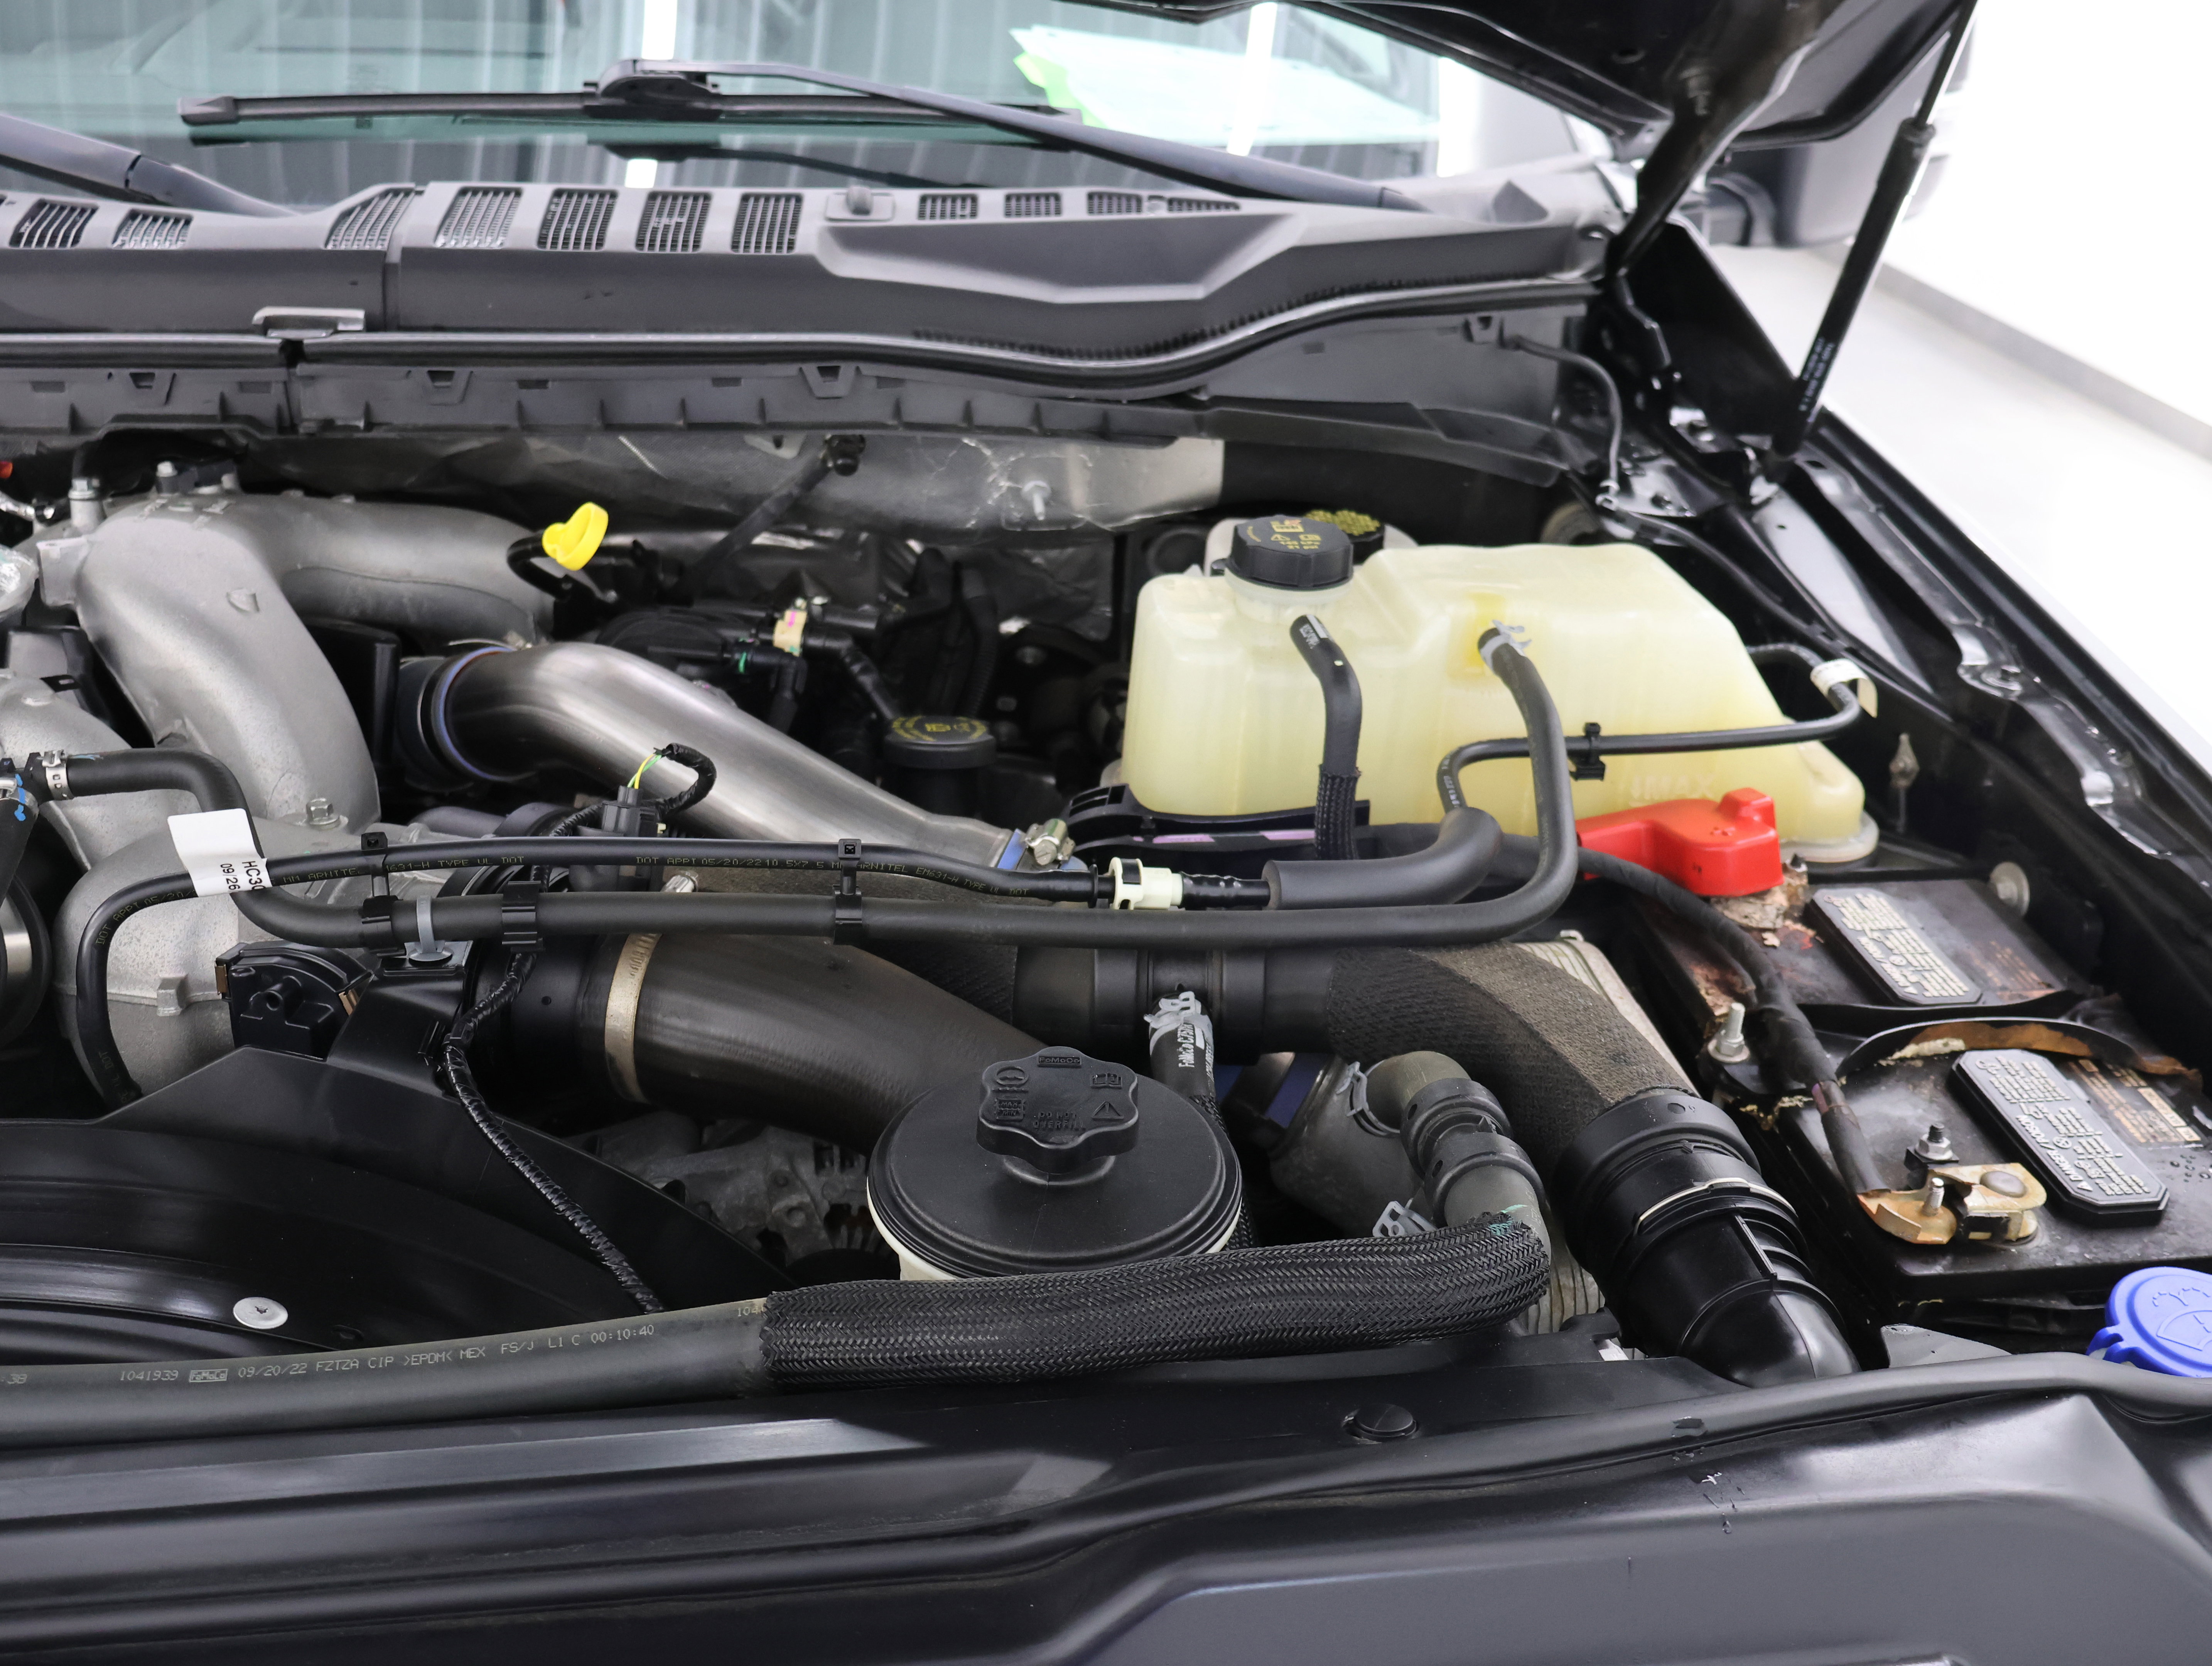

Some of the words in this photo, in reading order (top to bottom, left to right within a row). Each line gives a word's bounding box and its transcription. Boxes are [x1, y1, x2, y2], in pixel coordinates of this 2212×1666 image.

[120, 1370, 179, 1382] 1041939
[192, 1370, 226, 1380] FoMoCo
[238, 1362, 307, 1378] 09/20/22
[368, 1357, 394, 1368] CIP
[460, 1347, 486, 1359] MEX
